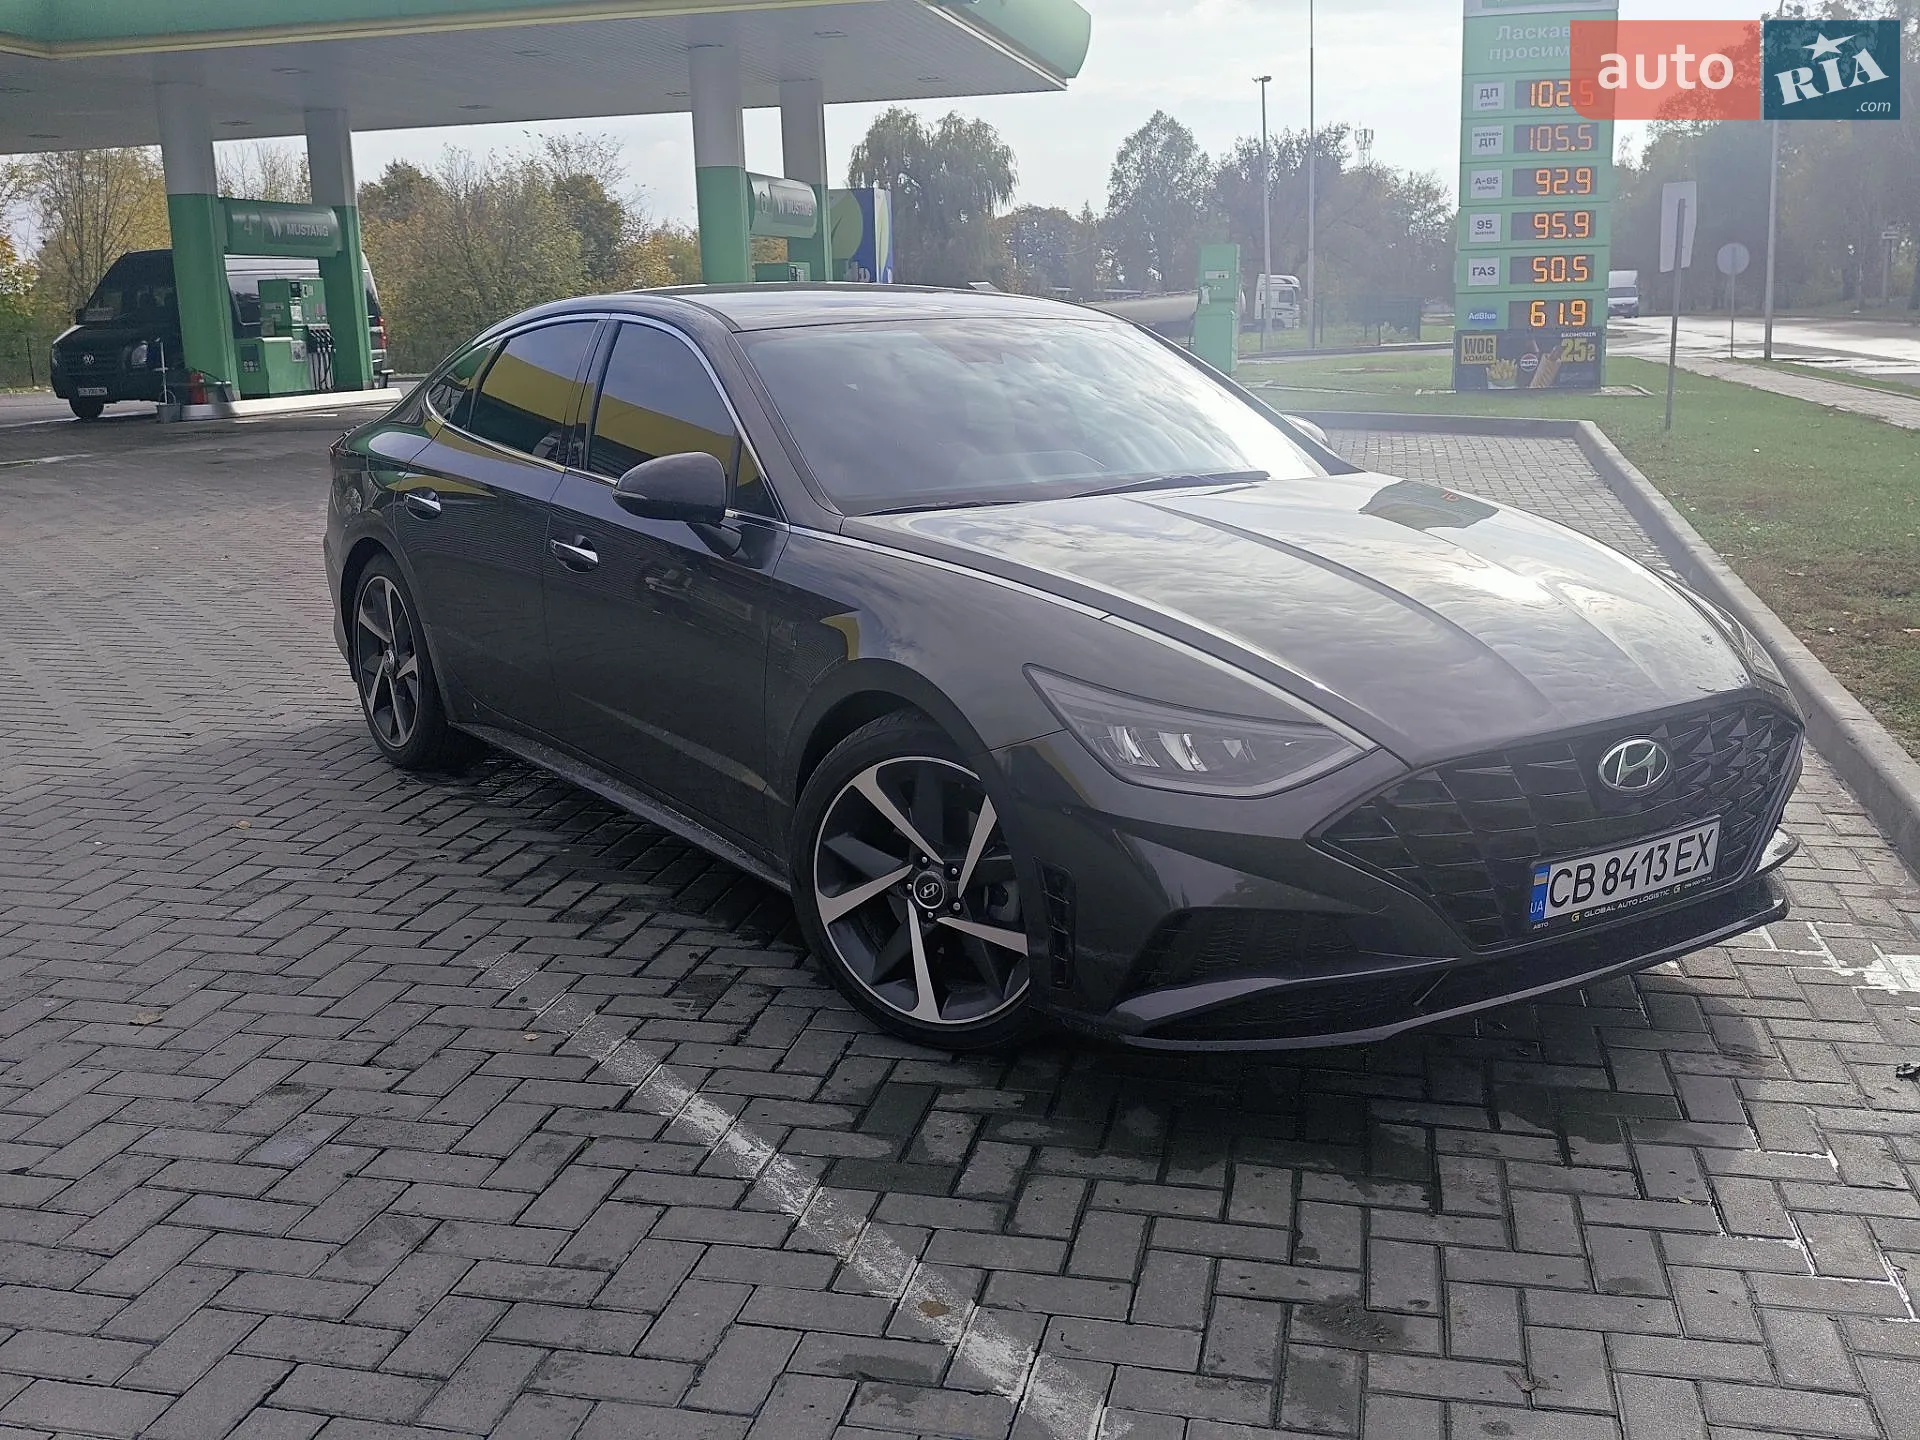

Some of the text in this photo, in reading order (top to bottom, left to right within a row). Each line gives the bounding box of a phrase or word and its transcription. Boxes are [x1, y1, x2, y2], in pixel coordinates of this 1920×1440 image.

[1479, 87, 1499, 100] ДП
[1479, 137, 1496, 148] ДП
[1529, 124, 1593, 152] 105.5
[1535, 167, 1592, 196] 92.9
[286, 223, 329, 237] MUSTANG
[1476, 219, 1493, 230] 95
[1534, 211, 1590, 239] 95.9
[1472, 266, 1496, 276] ГАЗ
[1532, 255, 1588, 283] 50.5
[1468, 311, 1497, 321] AdBlue
[1529, 900, 1544, 914] UA
[1583, 904, 1616, 918] GLOBAL
[1617, 898, 1638, 909] AUTO
[1639, 889, 1670, 903] LOGISTIC
